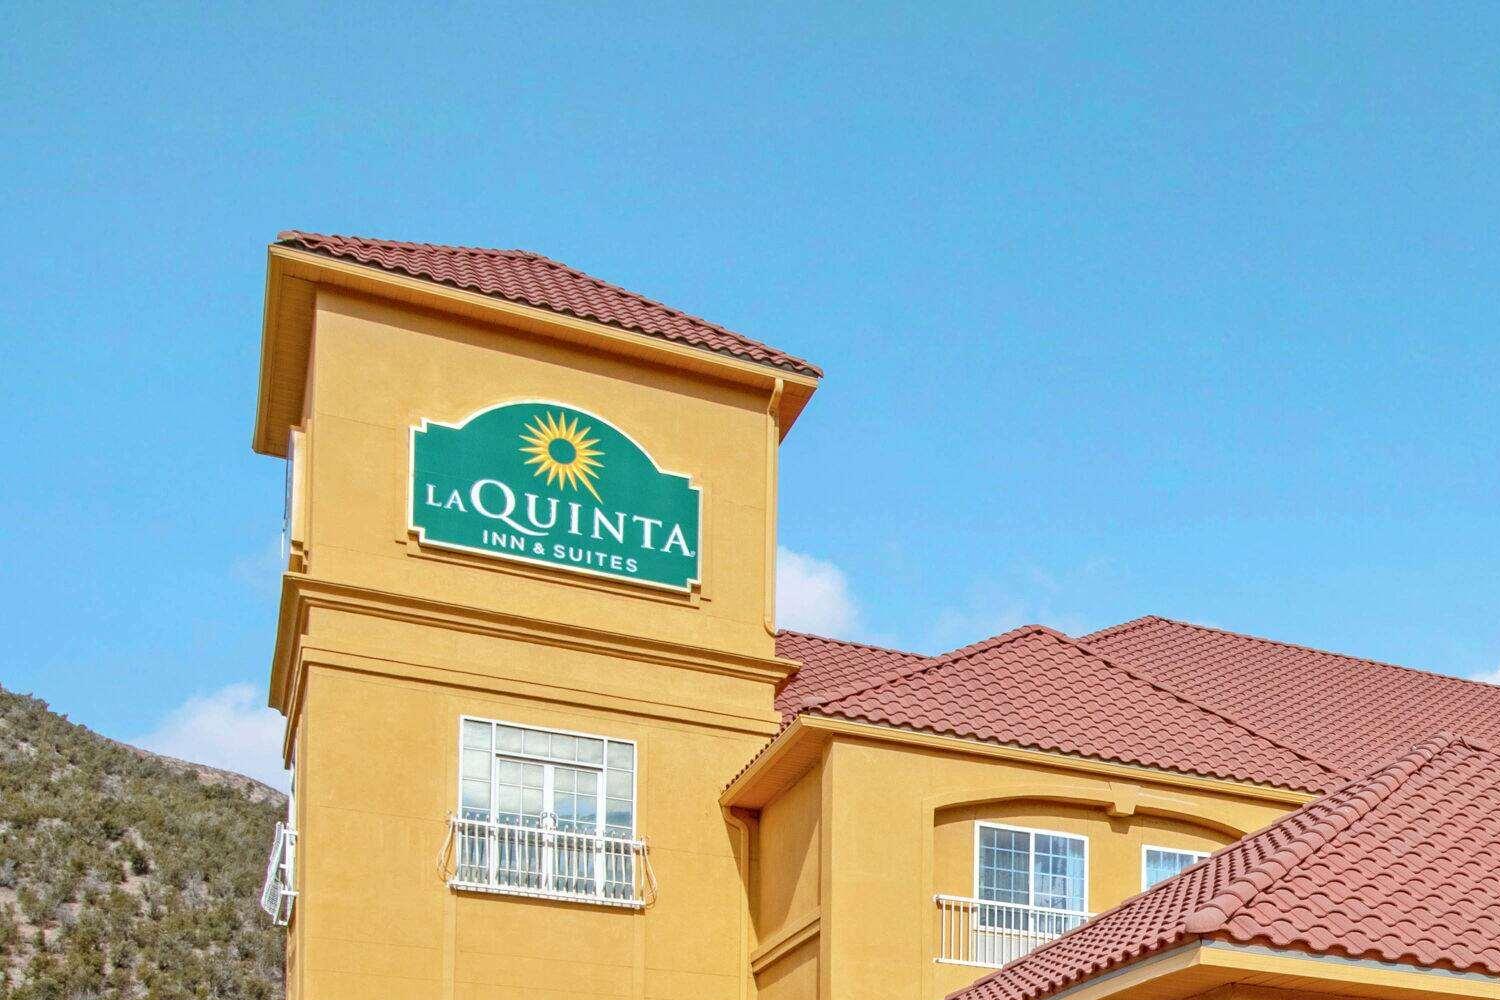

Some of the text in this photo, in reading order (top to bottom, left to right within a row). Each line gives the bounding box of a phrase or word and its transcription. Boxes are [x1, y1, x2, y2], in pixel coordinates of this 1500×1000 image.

[425, 479, 691, 556] LA QUINTA
[482, 529, 638, 572] INN & SUITES
